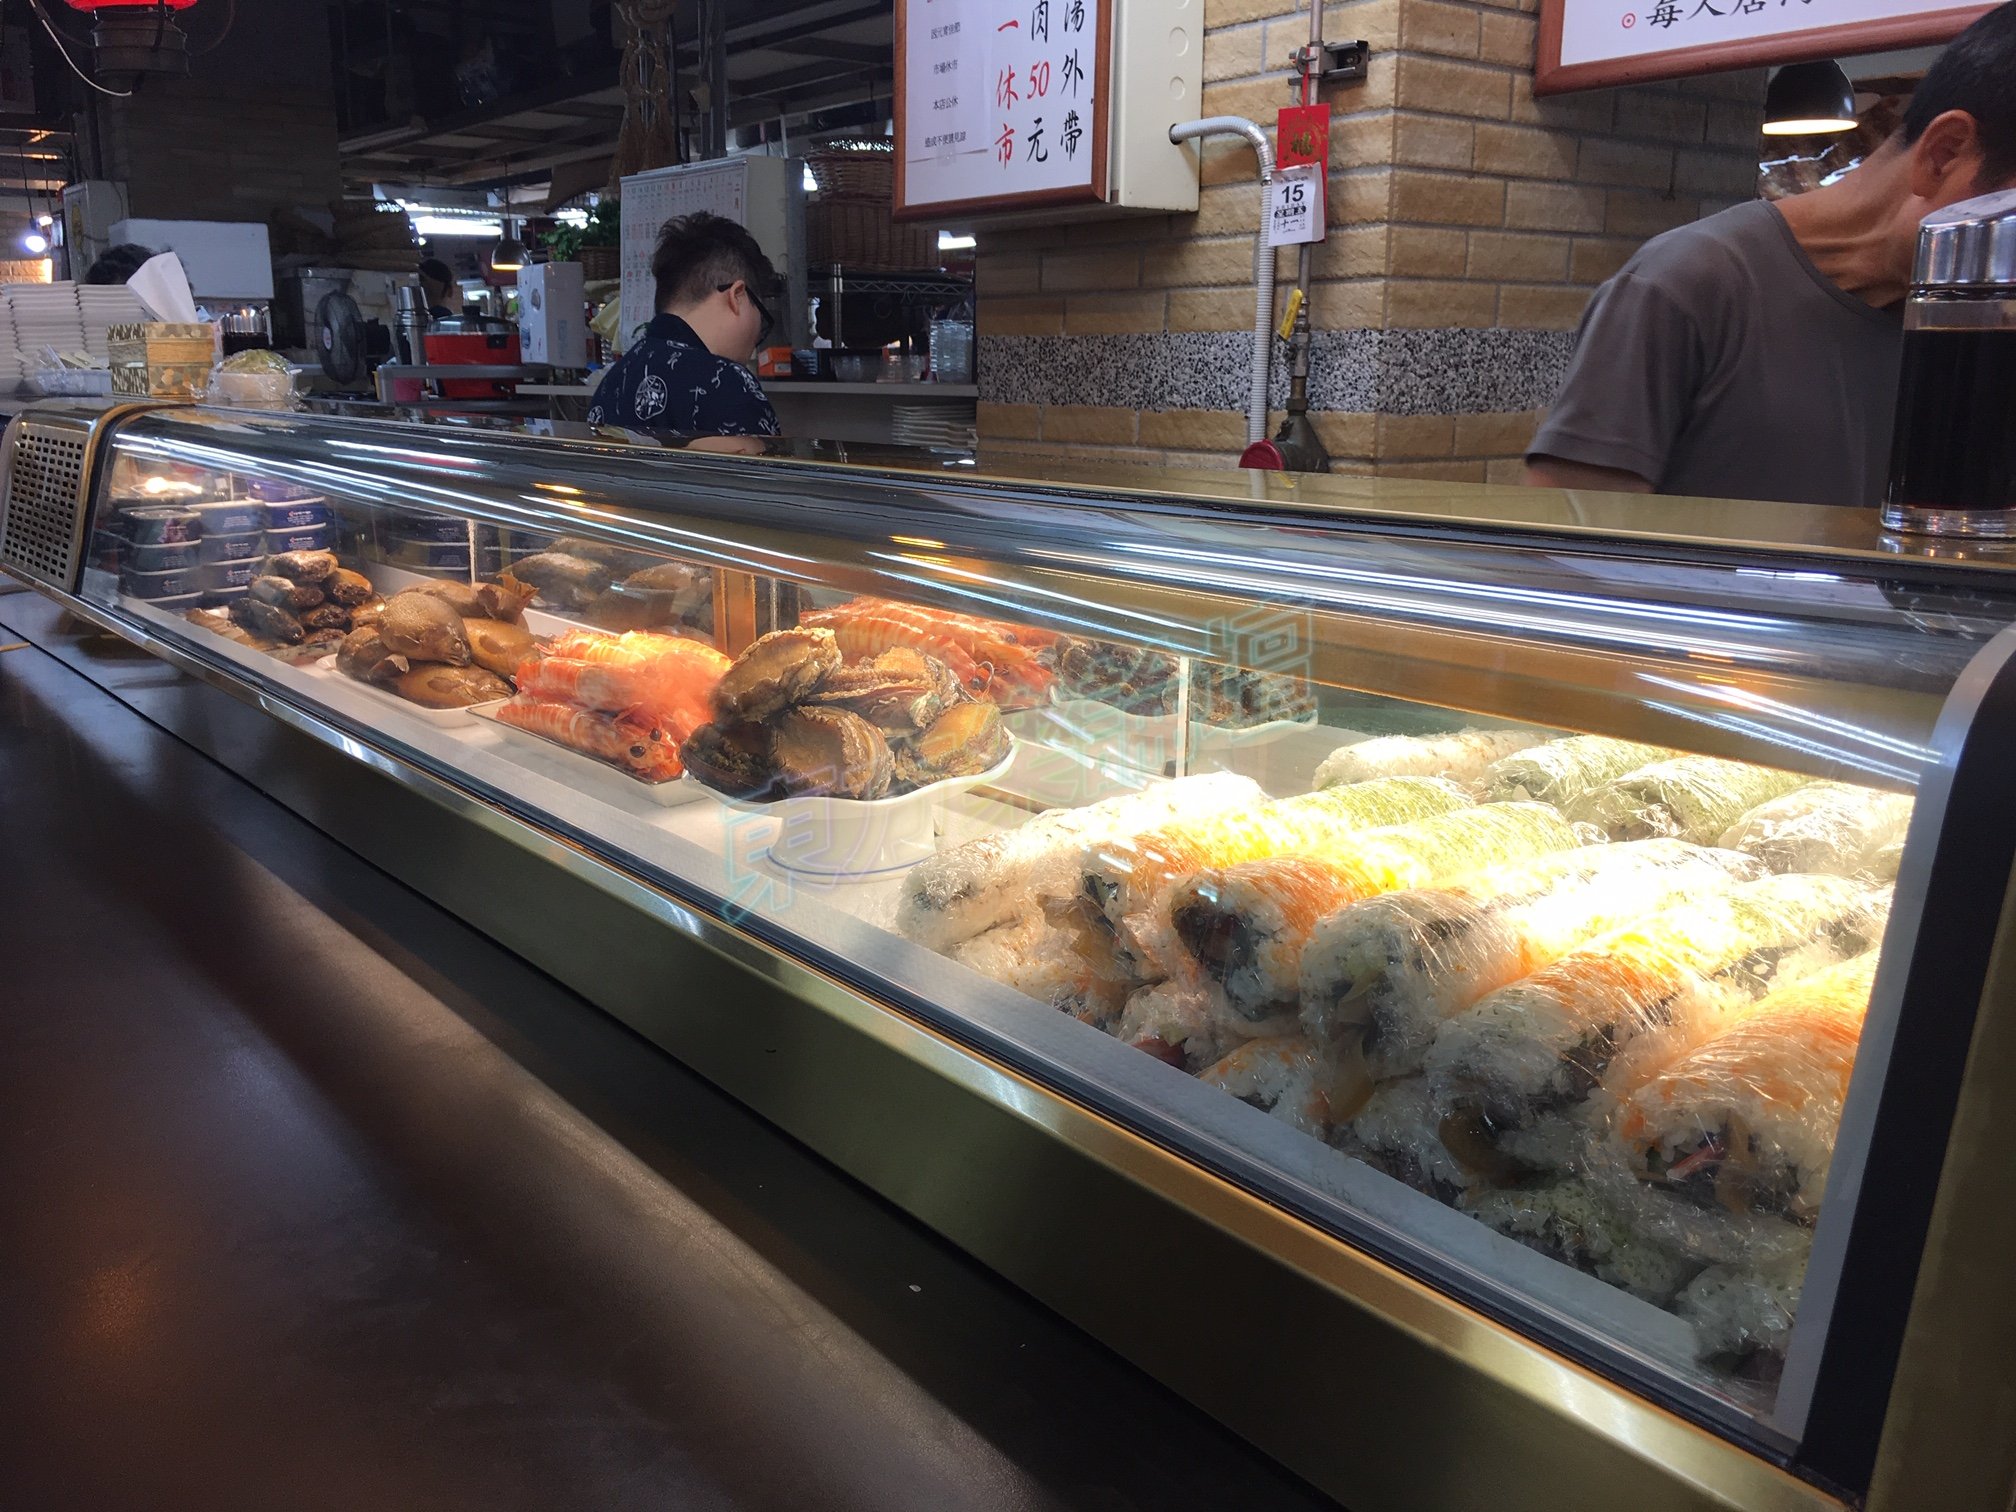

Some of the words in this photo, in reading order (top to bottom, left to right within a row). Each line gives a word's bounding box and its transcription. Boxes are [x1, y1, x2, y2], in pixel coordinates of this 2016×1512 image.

[933, 60, 958, 75] 市場休市
[932, 96, 959, 111] 本店公休
[1282, 184, 1304, 204] 15
